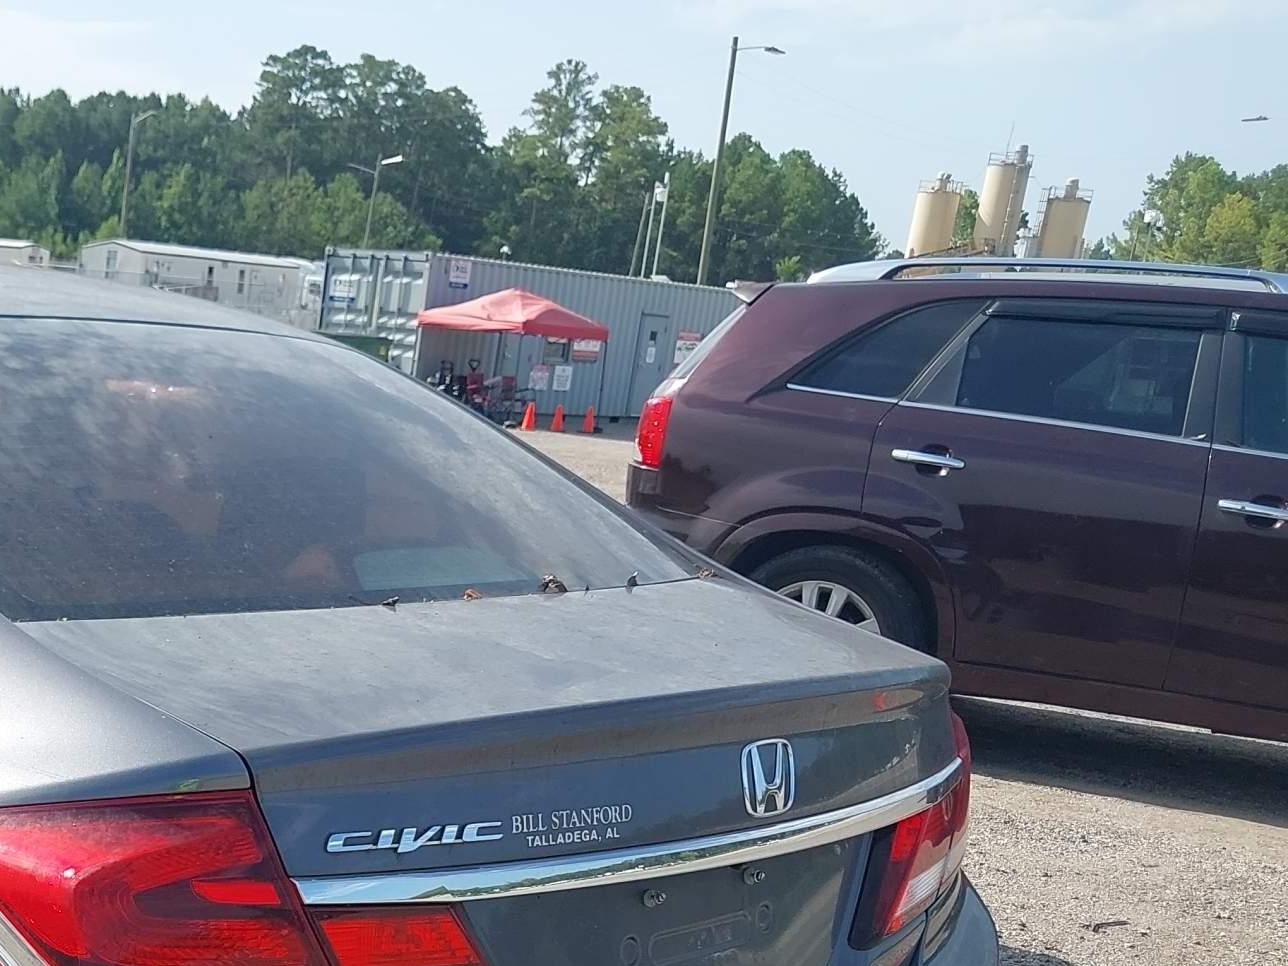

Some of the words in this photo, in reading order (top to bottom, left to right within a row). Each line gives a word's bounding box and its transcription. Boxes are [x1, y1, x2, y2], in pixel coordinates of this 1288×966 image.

[512, 811, 548, 835] BILL
[551, 804, 633, 829] STANFORD
[326, 821, 504, 853] CIVIC
[526, 830, 603, 848] TALLADEGA,
[606, 827, 621, 840] AL
